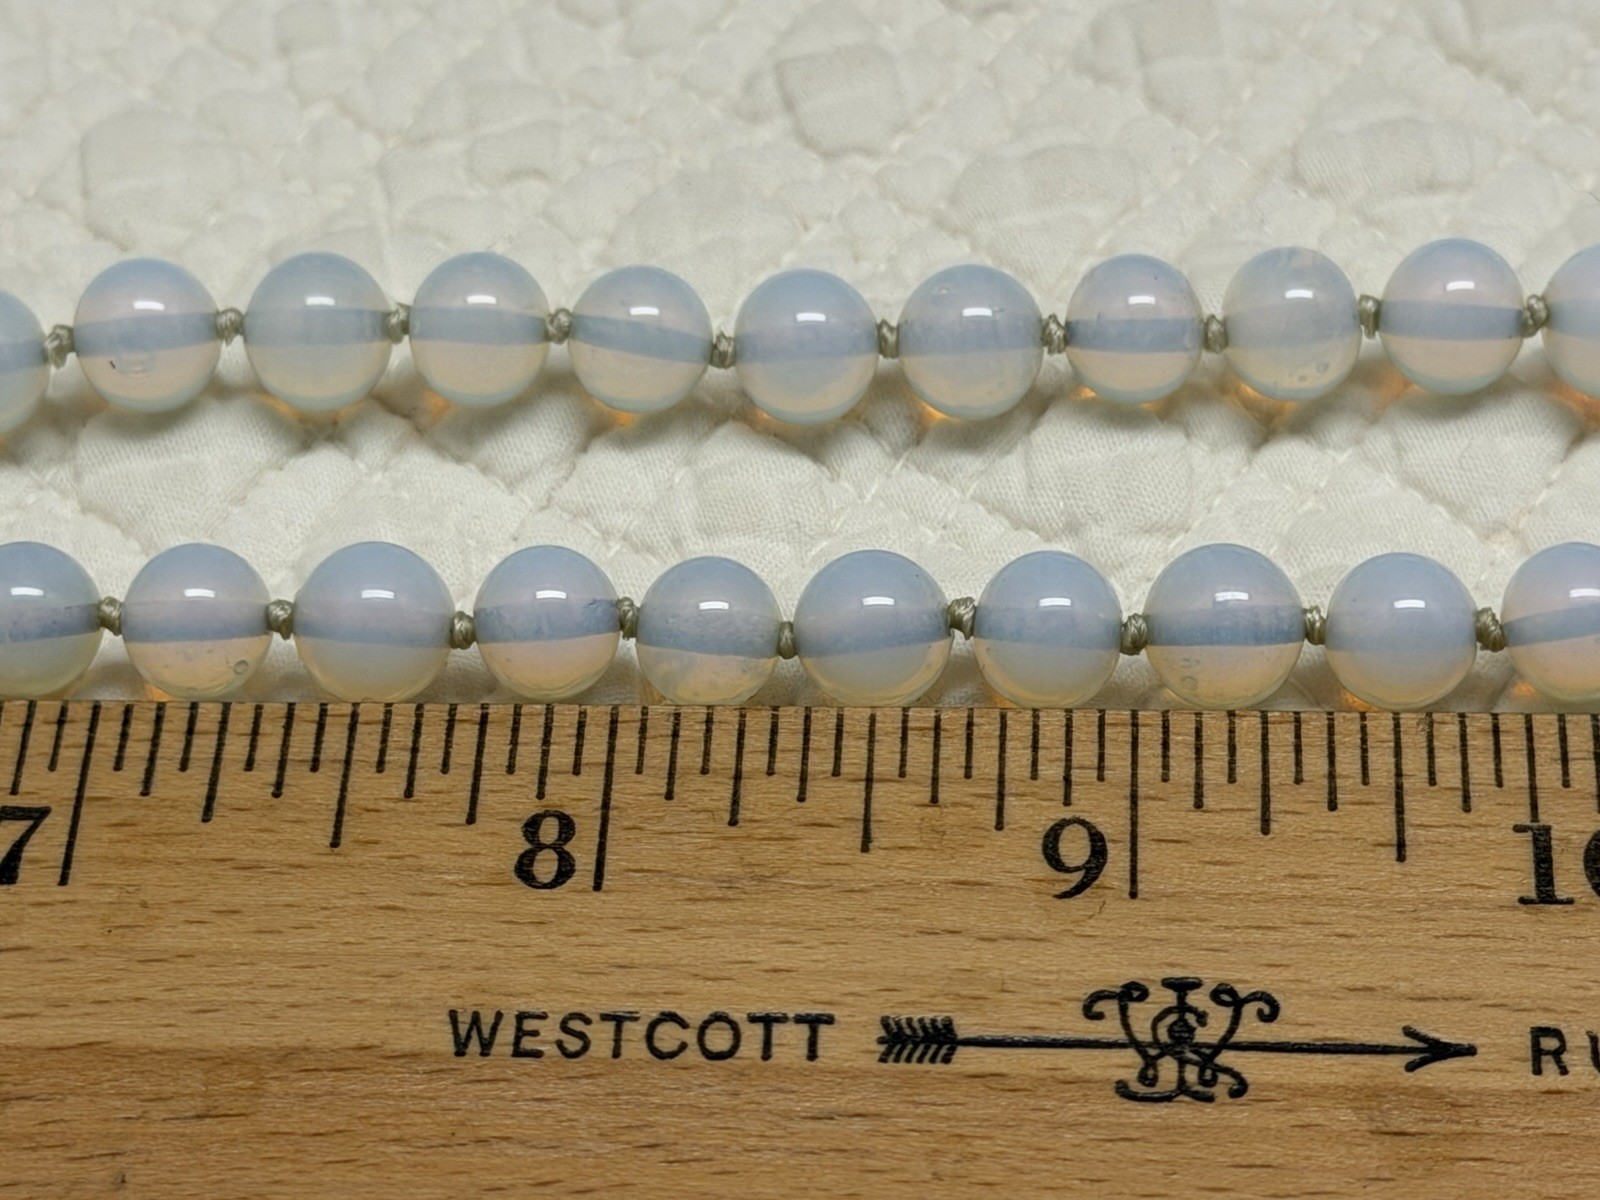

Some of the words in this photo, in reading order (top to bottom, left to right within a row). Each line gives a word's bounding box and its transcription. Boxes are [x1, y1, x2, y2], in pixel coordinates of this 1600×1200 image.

[0, 804, 52, 886] 7
[513, 808, 577, 890] 8
[1041, 815, 1109, 900] 9
[447, 1008, 836, 1063] WESTCOTT
